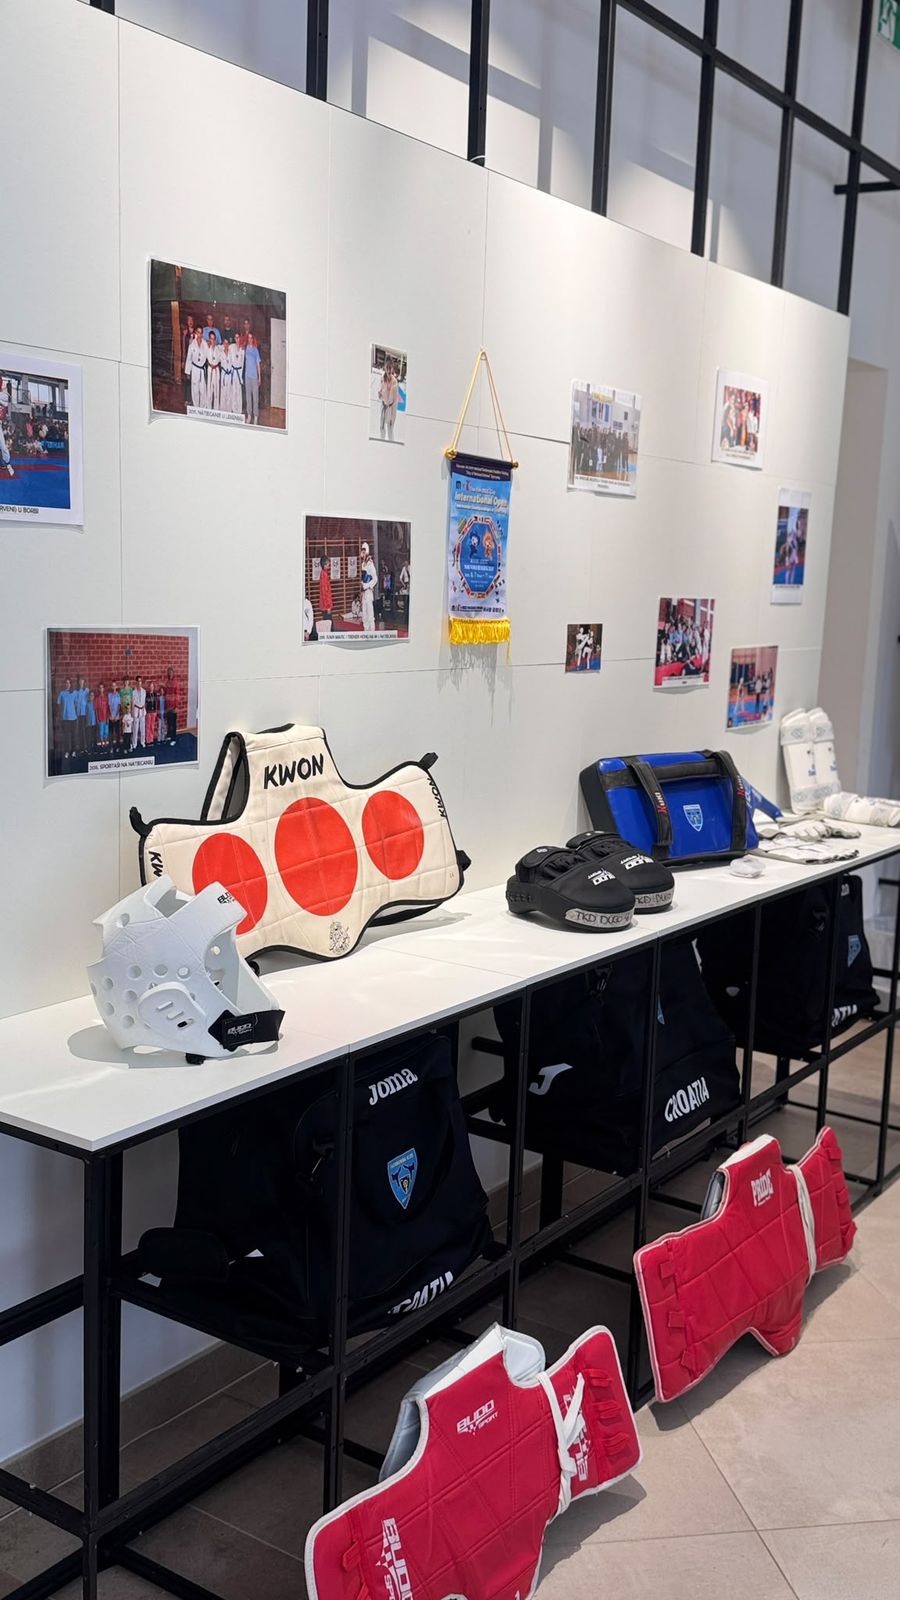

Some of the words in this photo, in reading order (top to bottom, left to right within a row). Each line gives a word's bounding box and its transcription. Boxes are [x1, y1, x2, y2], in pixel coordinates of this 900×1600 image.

[263, 753, 324, 790] KWON
[148, 850, 164, 877] KW
[574, 910, 597, 923] TKD
[368, 1068, 419, 1106] Joma
[664, 1076, 710, 1122] CROATIA
[456, 1399, 496, 1432] BUDO
[478, 1410, 499, 1429] SPORT
[383, 1517, 414, 1600] BUD
